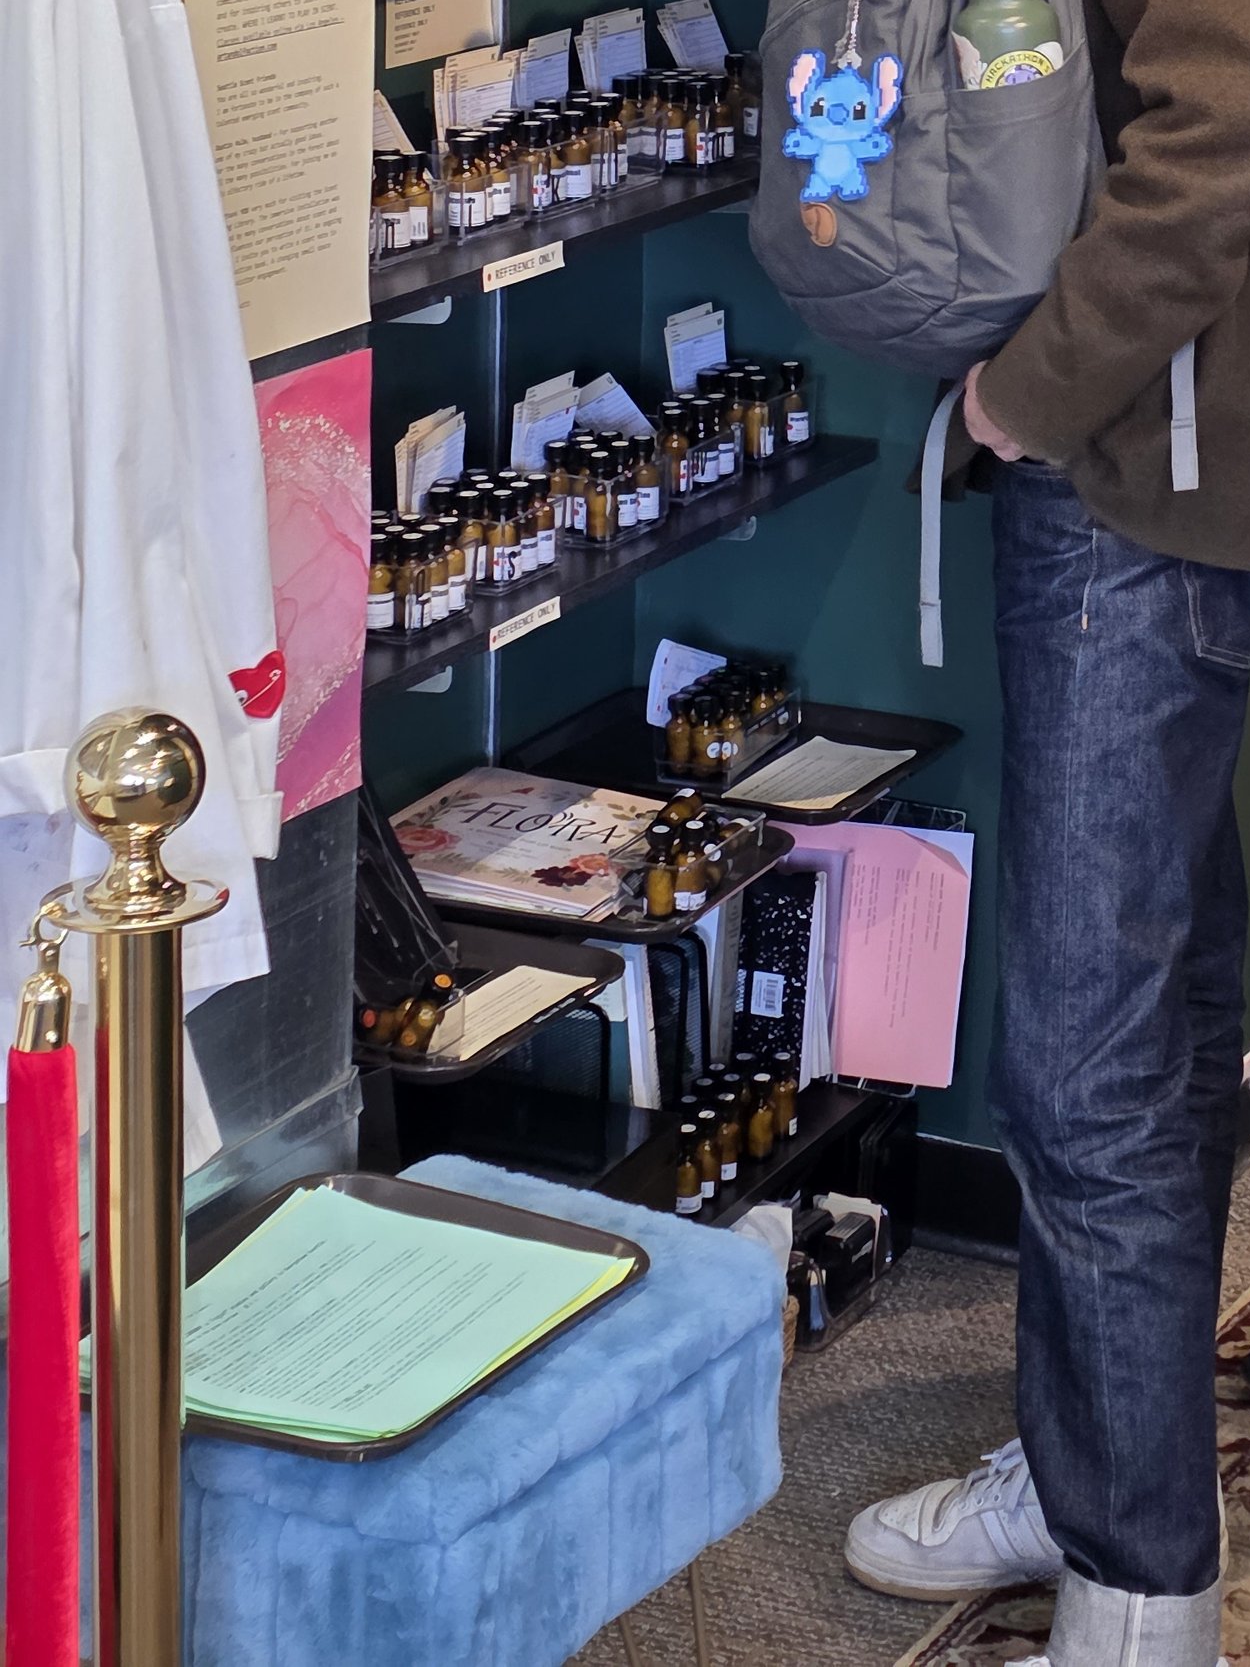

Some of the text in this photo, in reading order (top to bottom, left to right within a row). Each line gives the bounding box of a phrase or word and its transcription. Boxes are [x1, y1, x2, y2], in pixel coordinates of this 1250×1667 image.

[495, 250, 556, 279] REFERENCE ONLY
[459, 801, 625, 844] FLORA
